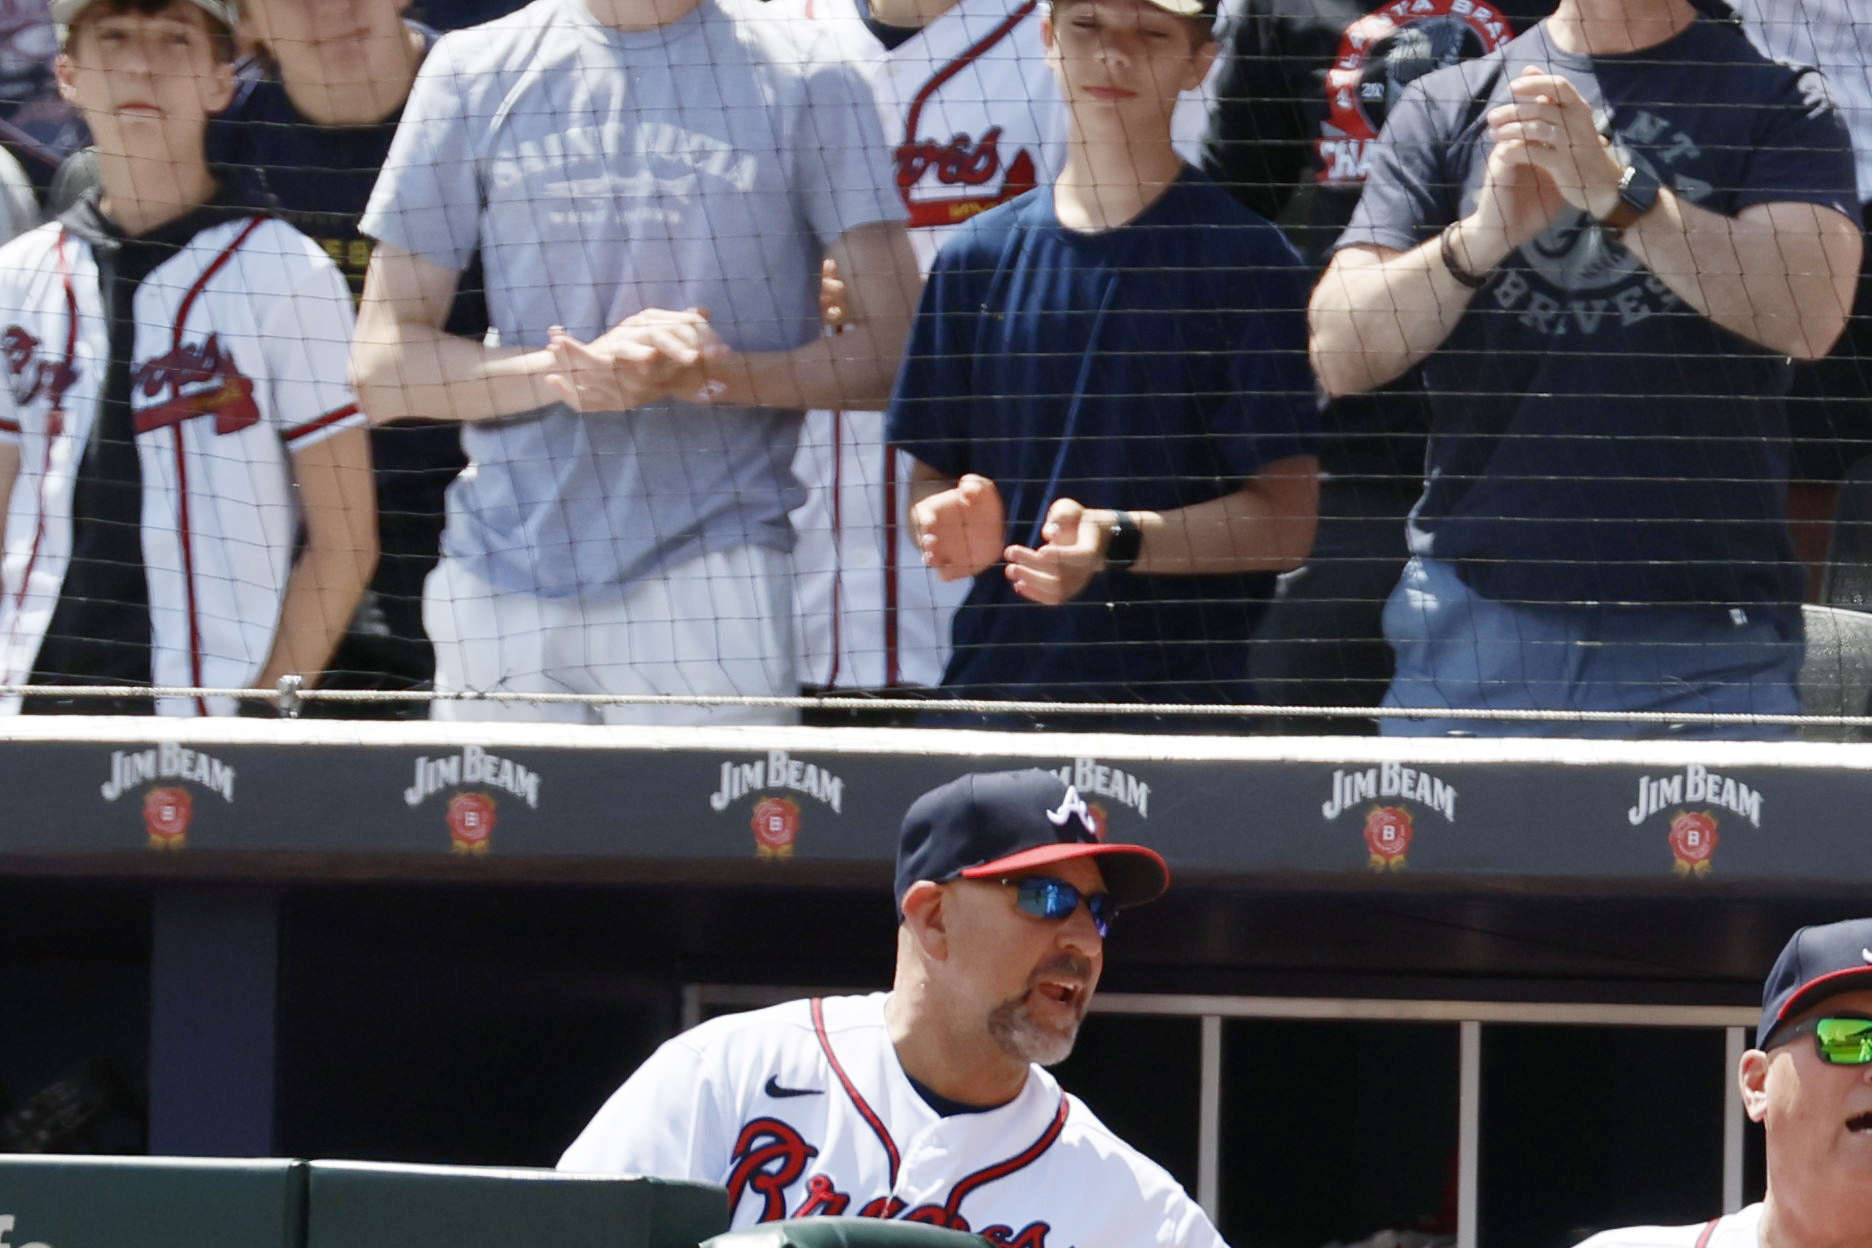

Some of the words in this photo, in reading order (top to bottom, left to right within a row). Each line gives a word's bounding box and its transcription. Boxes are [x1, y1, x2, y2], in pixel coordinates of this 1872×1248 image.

[101, 751, 157, 802] JIM
[158, 740, 236, 803] BEAM
[404, 756, 460, 806] JIM
[463, 745, 542, 809] BEAM
[710, 761, 766, 811] JIM
[768, 750, 845, 814] BEAM
[1075, 757, 1152, 819] BEAM
[1322, 769, 1377, 820] JIM
[1380, 761, 1458, 823] BEAM
[1628, 775, 1683, 825] JIM
[1686, 764, 1765, 828] BEAM
[1046, 785, 1096, 834] A
[1382, 825, 1396, 841] B
[1687, 830, 1700, 846] B
